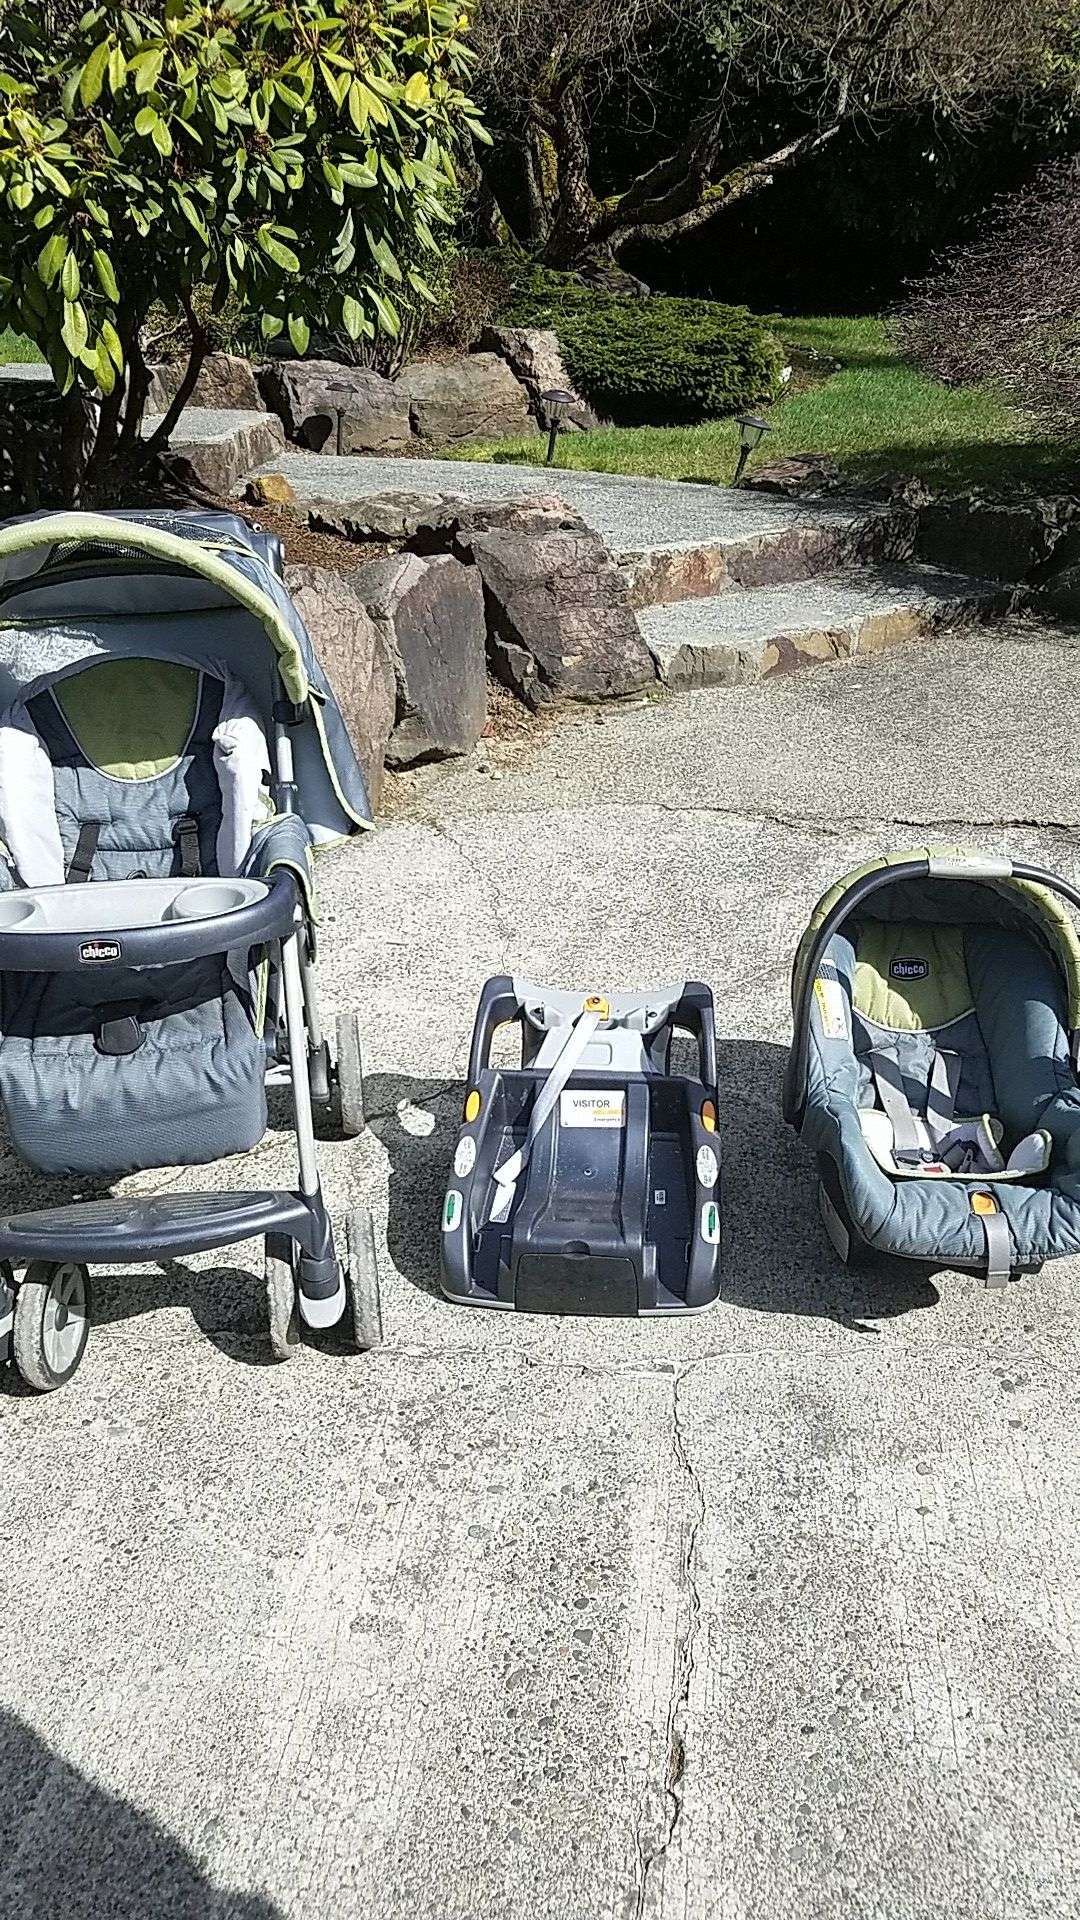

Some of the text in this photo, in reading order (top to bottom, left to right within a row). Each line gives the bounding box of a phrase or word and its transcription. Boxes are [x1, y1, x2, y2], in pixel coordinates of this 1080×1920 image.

[82, 943, 118, 959] chicco
[893, 962, 925, 975] chicco
[572, 1099, 610, 1108] VISITOR
